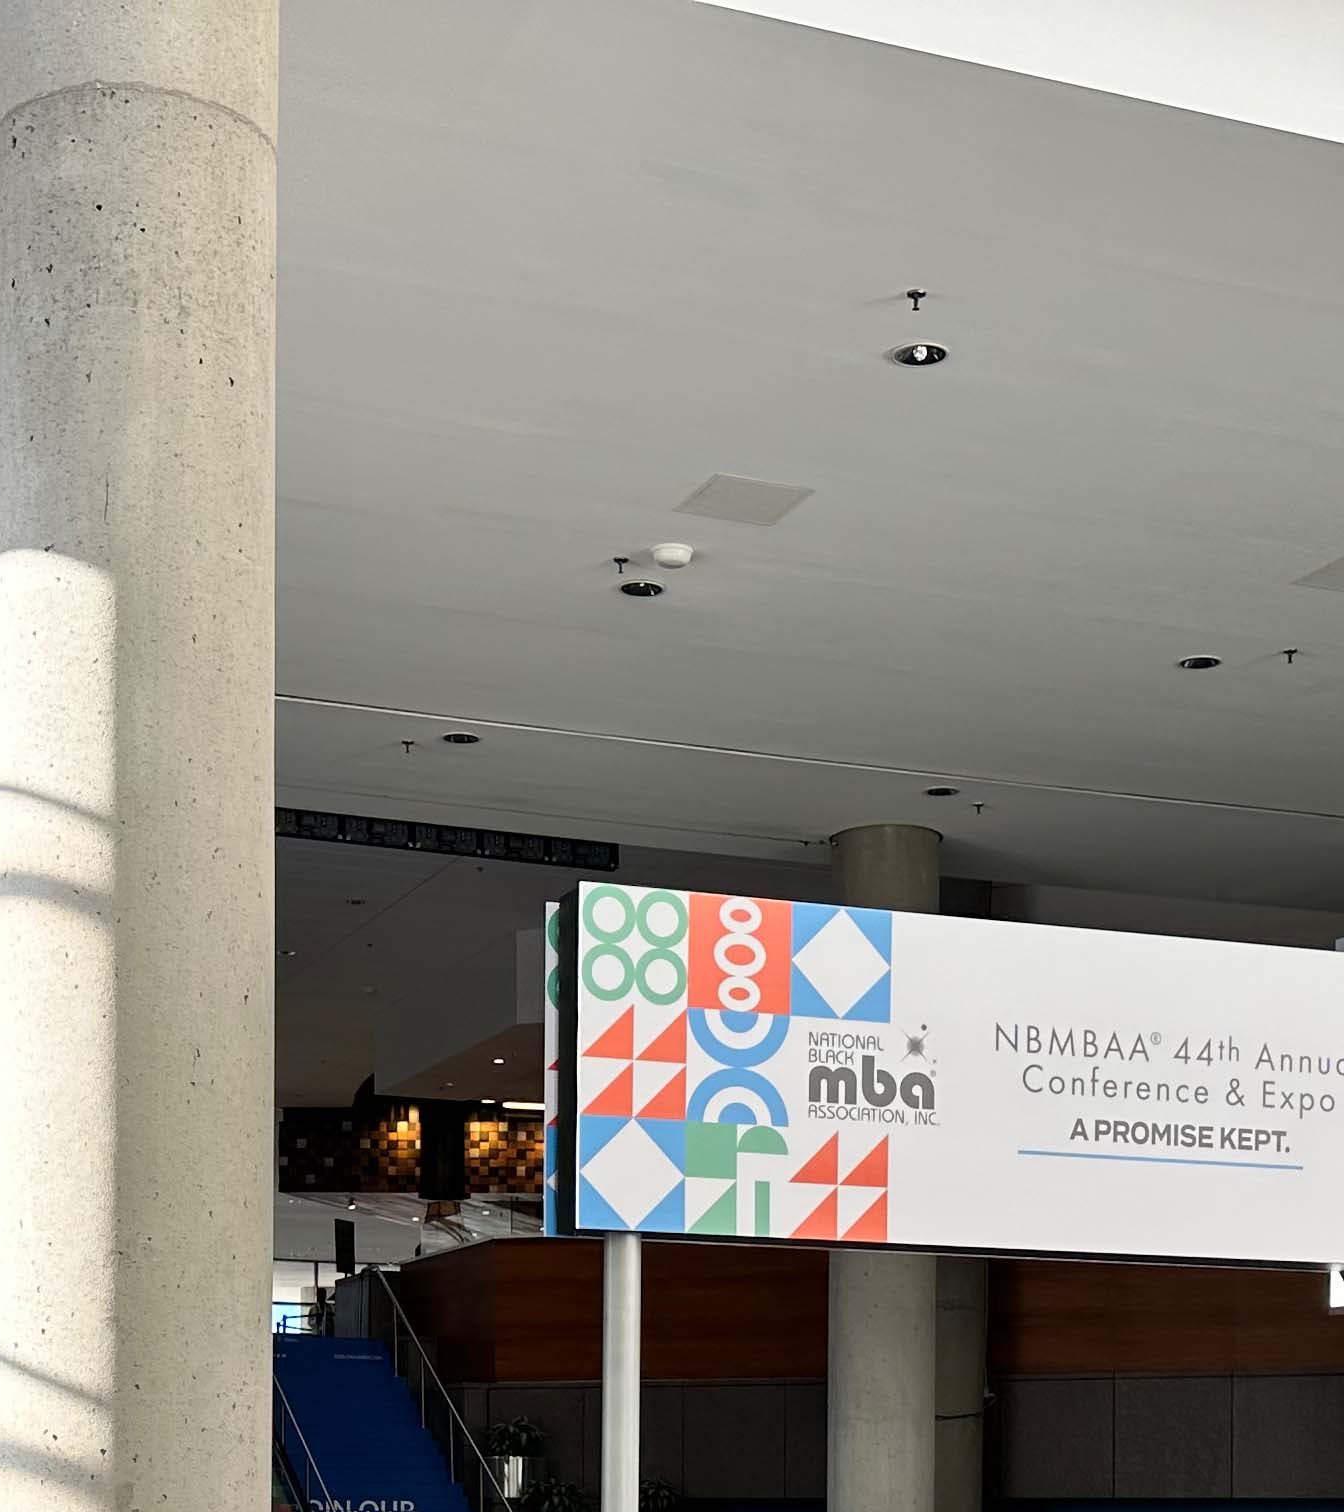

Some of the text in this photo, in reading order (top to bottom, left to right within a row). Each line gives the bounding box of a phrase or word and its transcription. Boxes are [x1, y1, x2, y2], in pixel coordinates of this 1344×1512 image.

[808, 1031, 884, 1052] NATIONAL
[1173, 1035, 1241, 1066] 44th
[808, 1048, 855, 1066] BLACK
[1022, 1064, 1336, 1119] Conference & Expo
[808, 1104, 941, 1126] ASSOCIATION, INC.
[1069, 1118, 1290, 1153] A PROMISE KEPT.
